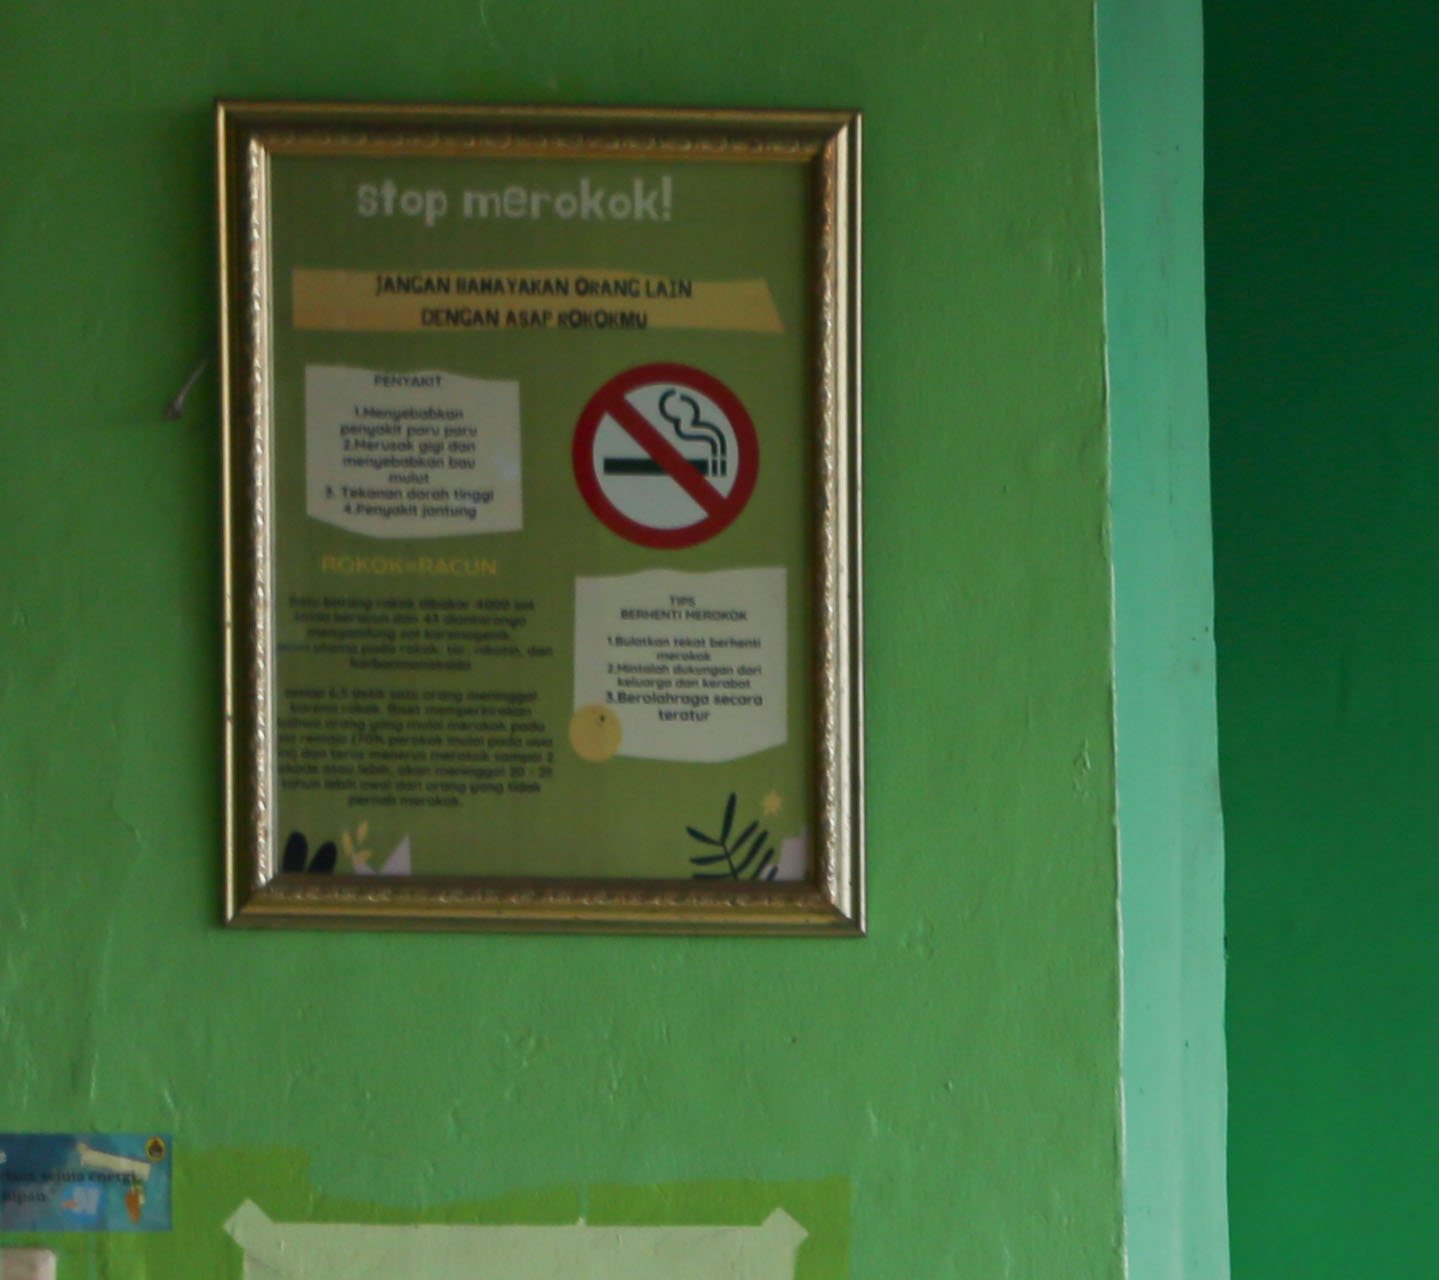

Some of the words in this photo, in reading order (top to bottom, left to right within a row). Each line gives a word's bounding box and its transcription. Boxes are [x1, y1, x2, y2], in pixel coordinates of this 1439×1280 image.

[356, 179, 448, 228] stop
[463, 175, 673, 222] merokok!
[376, 276, 450, 297] JANGAN
[575, 276, 640, 297] ORANG
[646, 279, 692, 298] LAIN
[421, 307, 500, 328] DENGAN
[506, 308, 553, 328] ASAP
[558, 310, 648, 330] ROKOKMU
[374, 374, 442, 388] PENYAKIT
[620, 608, 683, 621] BERHENTI
[685, 608, 748, 621] MEROKOK
[714, 694, 763, 706] secara
[658, 709, 710, 722] teratur
